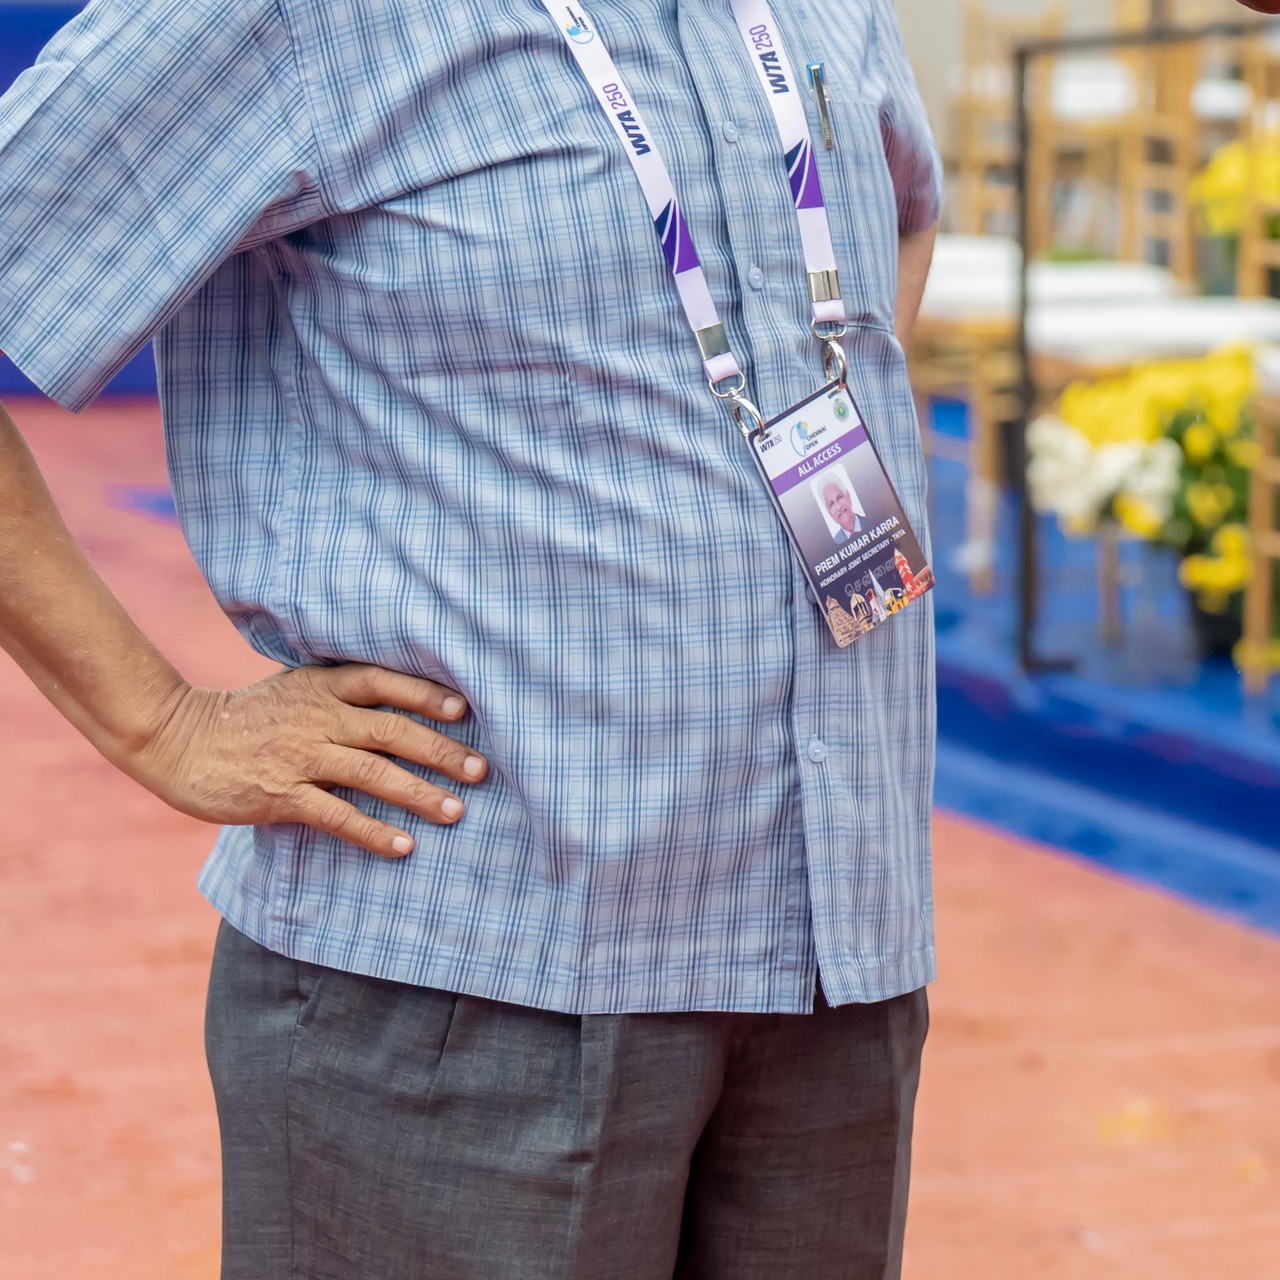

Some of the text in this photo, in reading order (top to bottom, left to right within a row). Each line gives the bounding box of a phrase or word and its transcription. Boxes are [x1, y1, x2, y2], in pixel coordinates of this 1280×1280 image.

[749, 24, 790, 94] WTA 250
[602, 82, 651, 155] WTA 250
[759, 439, 775, 453] WTA
[805, 439, 818, 451] OPEN
[806, 425, 827, 441] CHENNAI
[797, 442, 842, 477] ALL ACCESS
[814, 515, 900, 576] PREM KUMAR KARRA
[820, 566, 848, 588] HONORARY
[847, 557, 862, 571] JOINT
[861, 539, 891, 561] SECRETARY
[891, 528, 907, 541] TNTA
